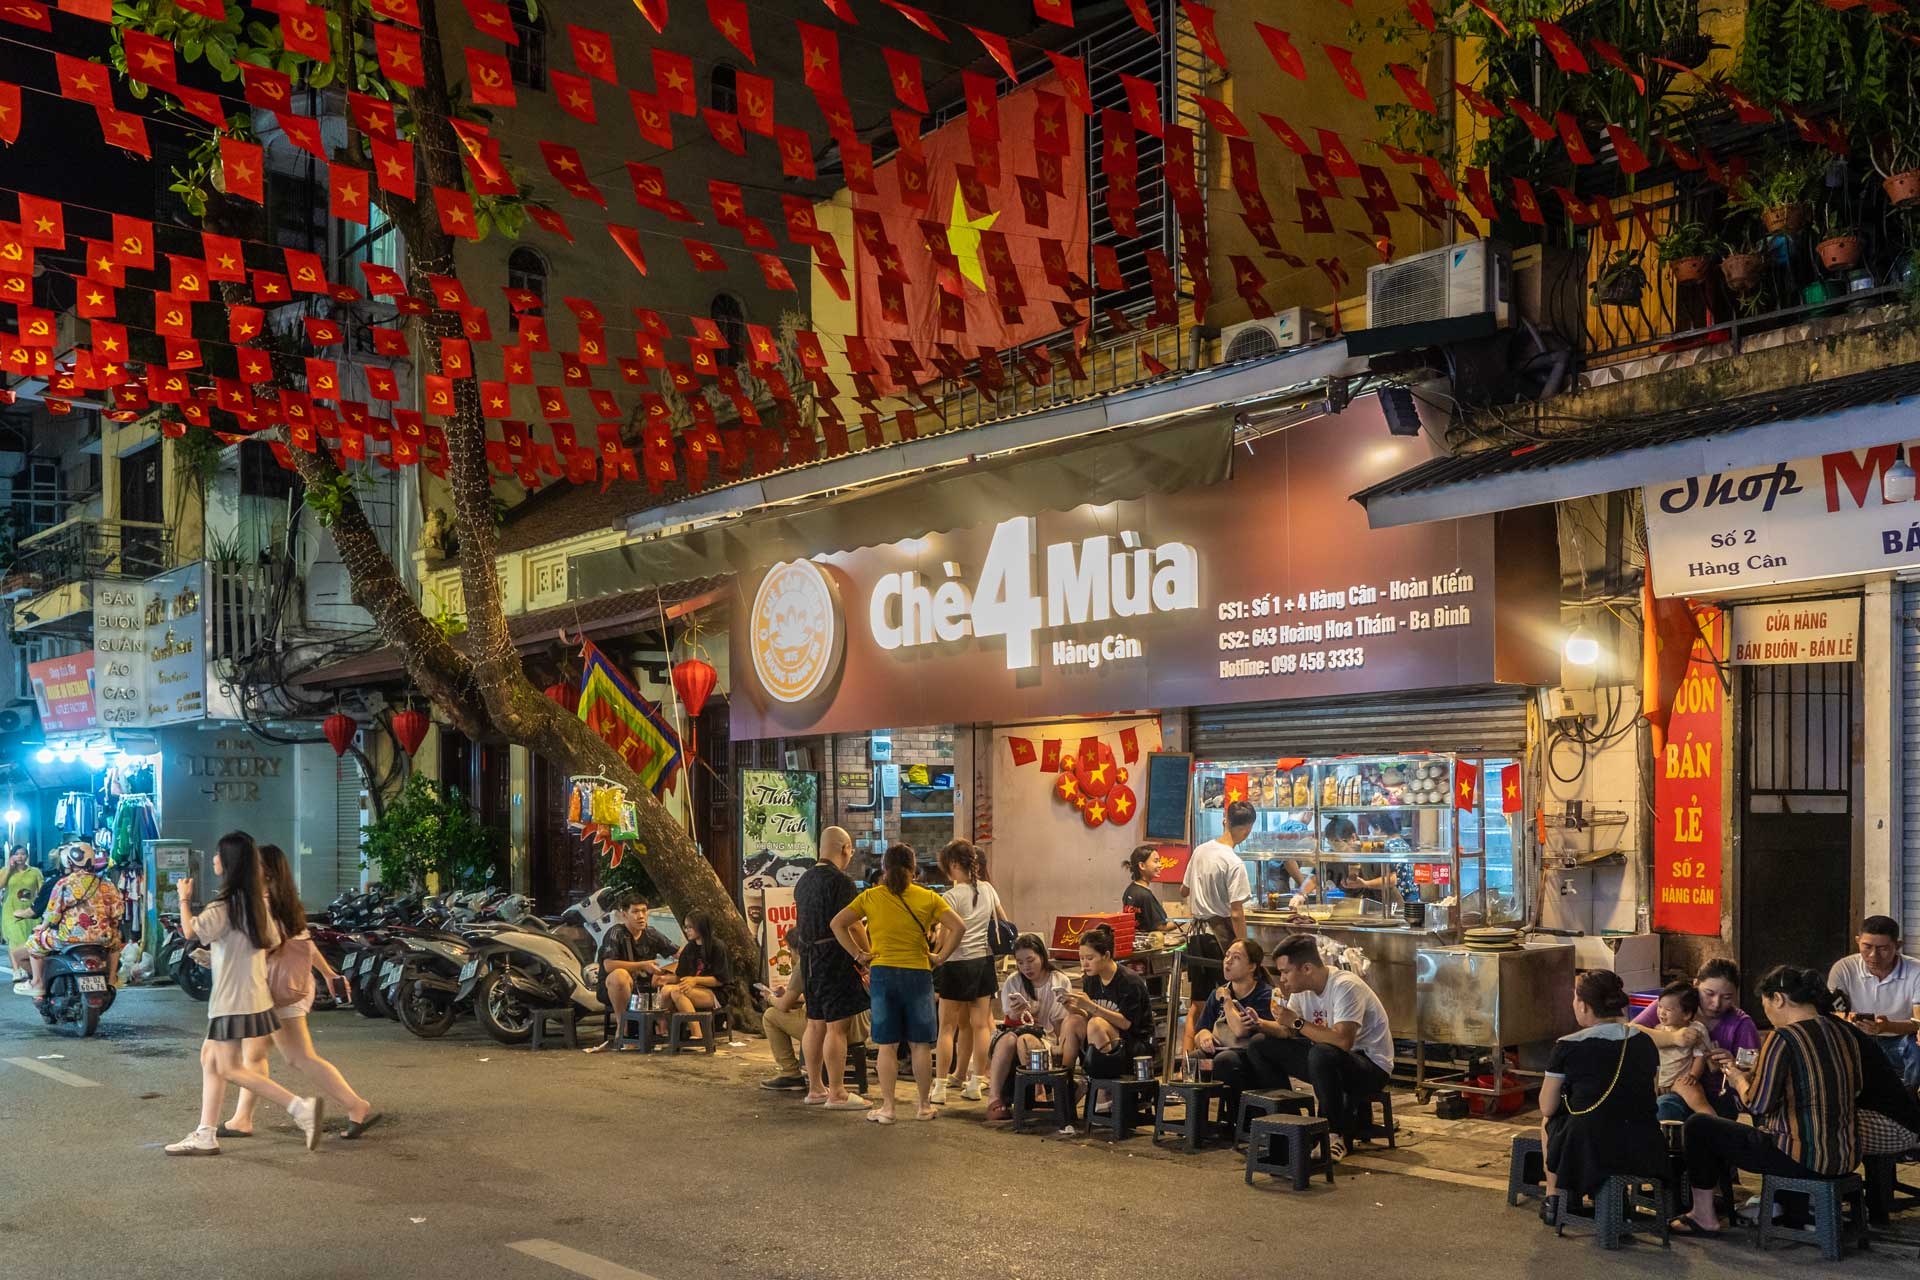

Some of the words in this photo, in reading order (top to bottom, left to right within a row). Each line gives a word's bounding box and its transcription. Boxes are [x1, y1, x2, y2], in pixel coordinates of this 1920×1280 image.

[1660, 462, 1803, 514] Shop
[1711, 530, 1737, 548] Số
[1743, 529, 1757, 544] 2
[1688, 561, 1740, 578] Hàng
[1746, 555, 1787, 570] Cân
[869, 561, 972, 650] Chè
[970, 516, 1041, 670] 4
[1047, 530, 1199, 628] Mùa
[1218, 600, 1249, 621] CS1:
[1251, 592, 1271, 617] Số
[1272, 596, 1280, 615] 1
[1284, 599, 1295, 611] +
[1297, 593, 1308, 611] 4
[1309, 589, 1346, 610] Hàng
[1348, 584, 1377, 606] Cân
[1389, 577, 1428, 601] Hoàn
[1431, 568, 1474, 595] Kiếm
[1219, 630, 1250, 650] CS2:
[1252, 627, 1277, 648] 643
[1279, 621, 1322, 644] Hoàng
[1325, 619, 1353, 639] Hoa
[1355, 613, 1396, 636] Thám
[1409, 610, 1430, 631] Ba
[1433, 604, 1470, 627] Đình
[1766, 609, 1790, 632] CỬA
[1793, 611, 1828, 631] HÀNG
[1052, 638, 1099, 669] Hàng
[1101, 634, 1142, 660] Cân
[1736, 640, 1761, 660] BÁN
[1764, 640, 1798, 659] BUÔN
[1809, 637, 1836, 657] BÁN
[1839, 633, 1853, 655] LẺ
[1219, 657, 1270, 679] Hotline:
[1271, 655, 1296, 675] 098
[1299, 651, 1325, 672] 458
[1327, 647, 1364, 668] 3333
[1674, 667, 1716, 714] UÔN
[188, 755, 283, 778] LUXURY
[1665, 732, 1711, 778] BÁN
[211, 780, 260, 802] FUR
[752, 785, 802, 806] Thất
[770, 813, 808, 836] Tịch
[1674, 795, 1703, 843] LẺ
[1672, 857, 1692, 878] SỐ
[1695, 863, 1705, 878] 2
[1661, 885, 1690, 904] HÀNG
[1692, 885, 1714, 905] CÂN
